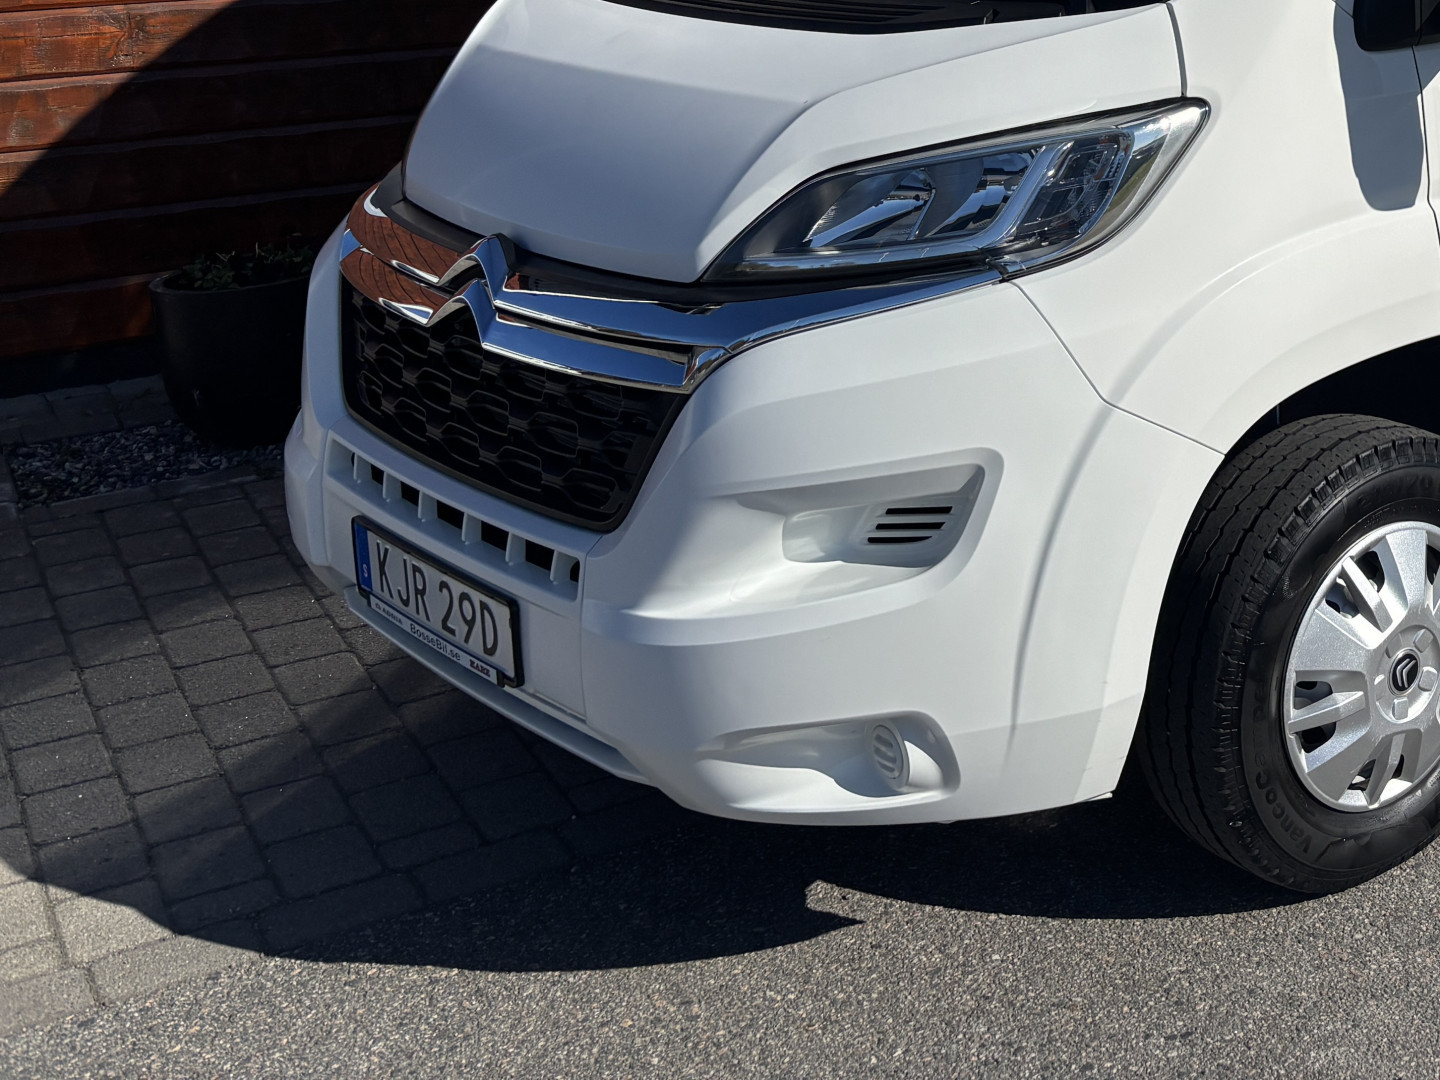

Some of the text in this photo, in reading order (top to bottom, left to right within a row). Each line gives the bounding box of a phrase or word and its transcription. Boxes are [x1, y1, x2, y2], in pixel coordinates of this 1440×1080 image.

[362, 563, 369, 578] S
[375, 539, 499, 657] KJR 29D
[409, 622, 461, 661] BosseBil.se
